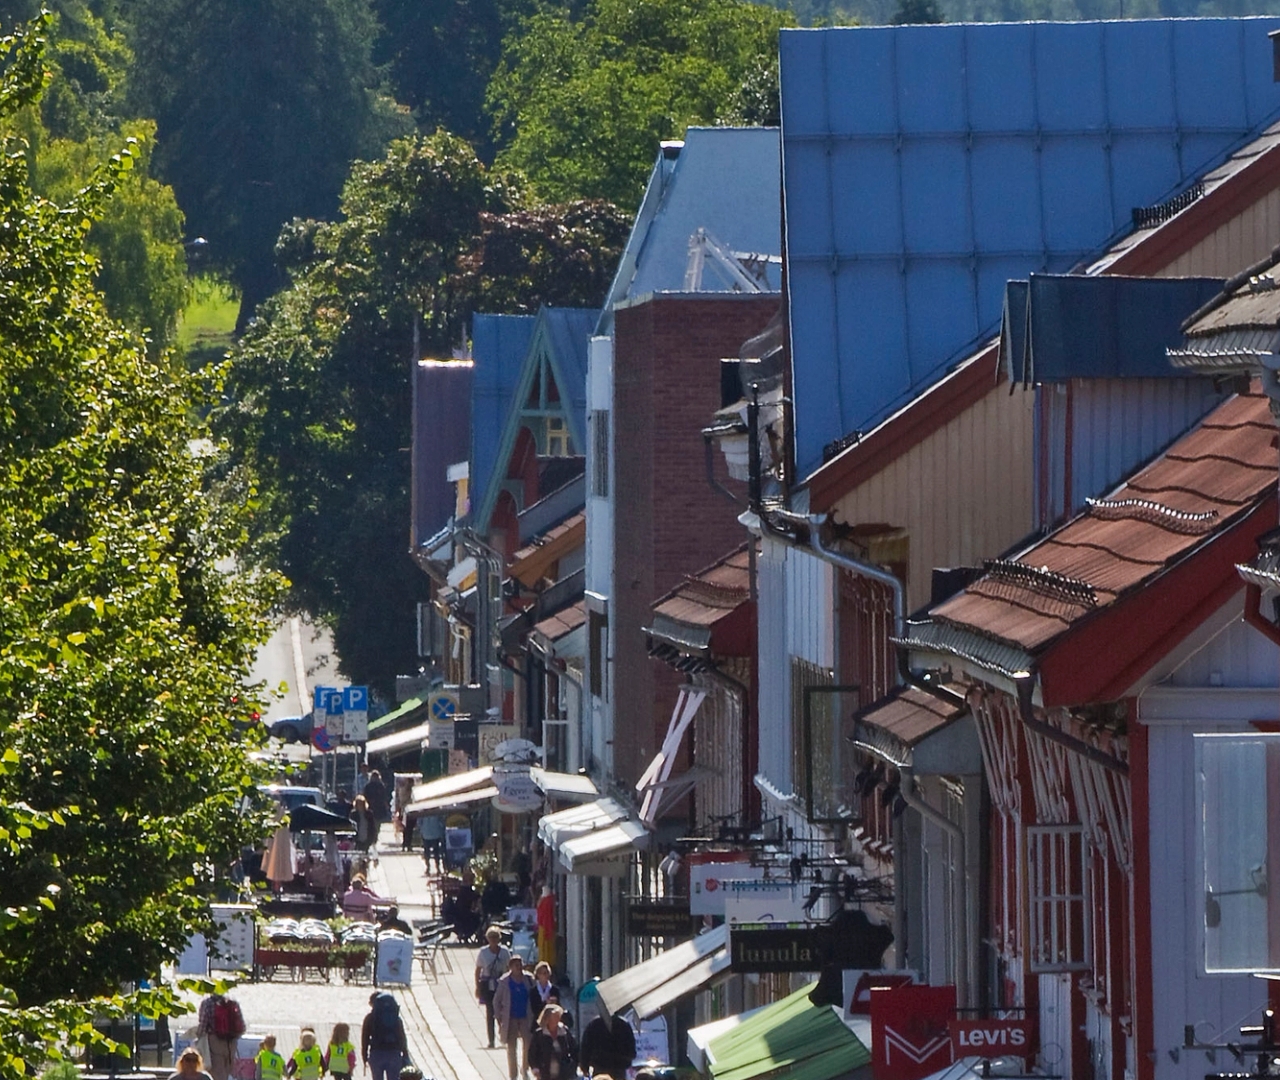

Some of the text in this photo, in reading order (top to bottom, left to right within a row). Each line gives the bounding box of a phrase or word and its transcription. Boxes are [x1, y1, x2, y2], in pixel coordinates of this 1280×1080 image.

[331, 695, 342, 713] P
[350, 690, 363, 708] P
[739, 941, 812, 963] lunula
